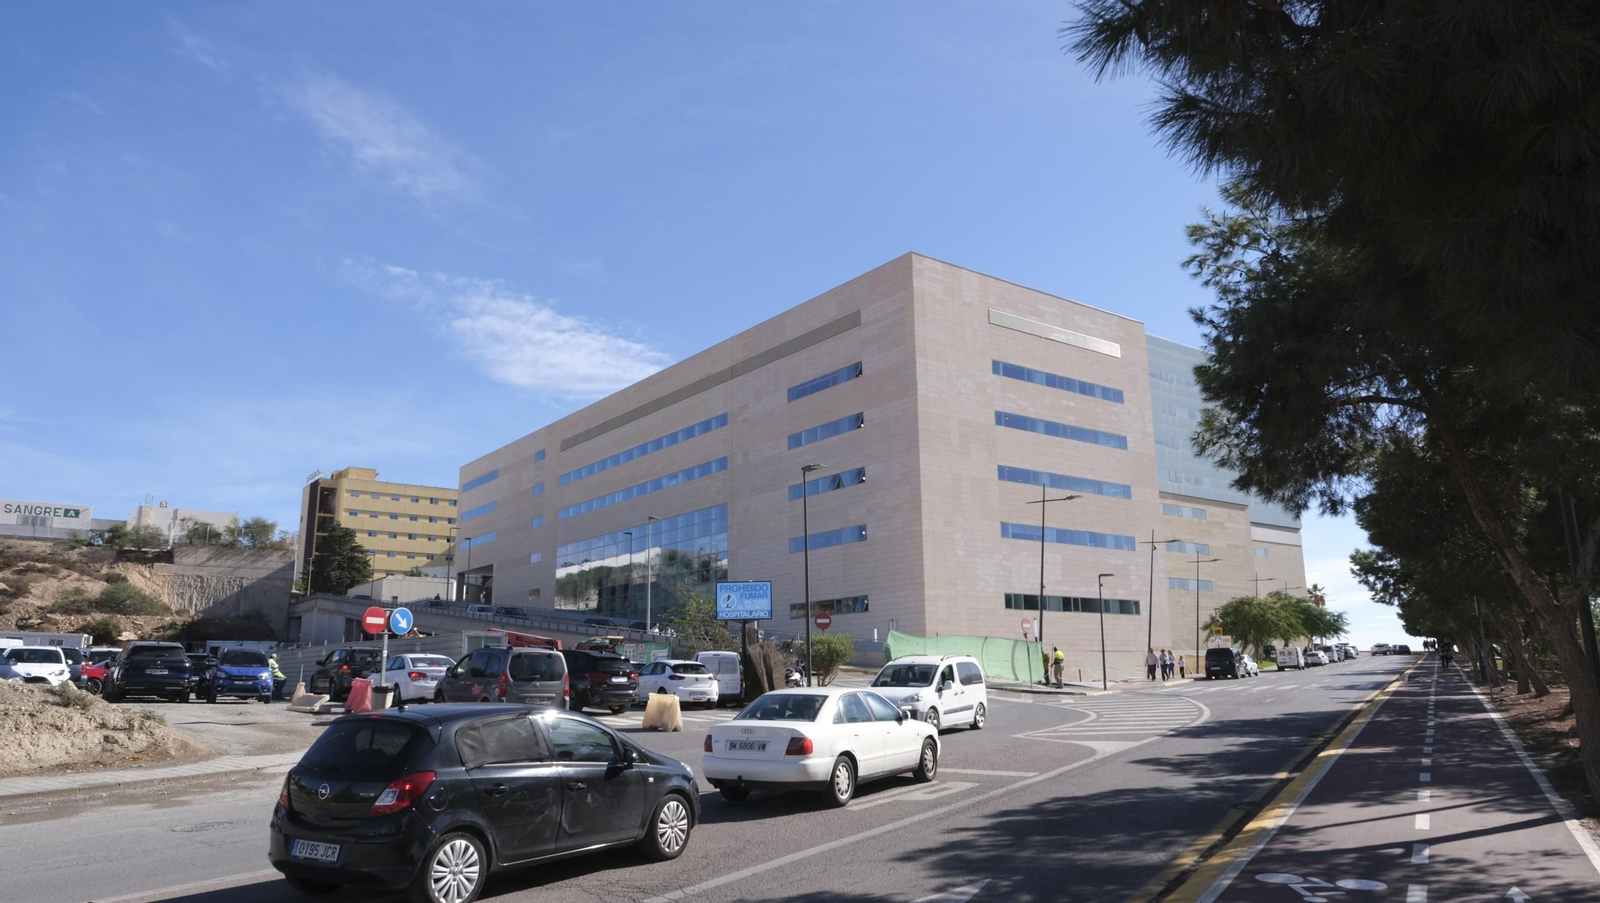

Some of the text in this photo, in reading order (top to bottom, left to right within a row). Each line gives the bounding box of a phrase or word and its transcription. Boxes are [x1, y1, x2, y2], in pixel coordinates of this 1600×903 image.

[4, 503, 62, 517] SANGRE
[719, 583, 769, 593] PROHIBIDO
[740, 592, 768, 600] FUMAR
[719, 610, 769, 618] HOSPITALARIO
[738, 742, 755, 751] 6806
[298, 842, 337, 859] 0195 JCR
